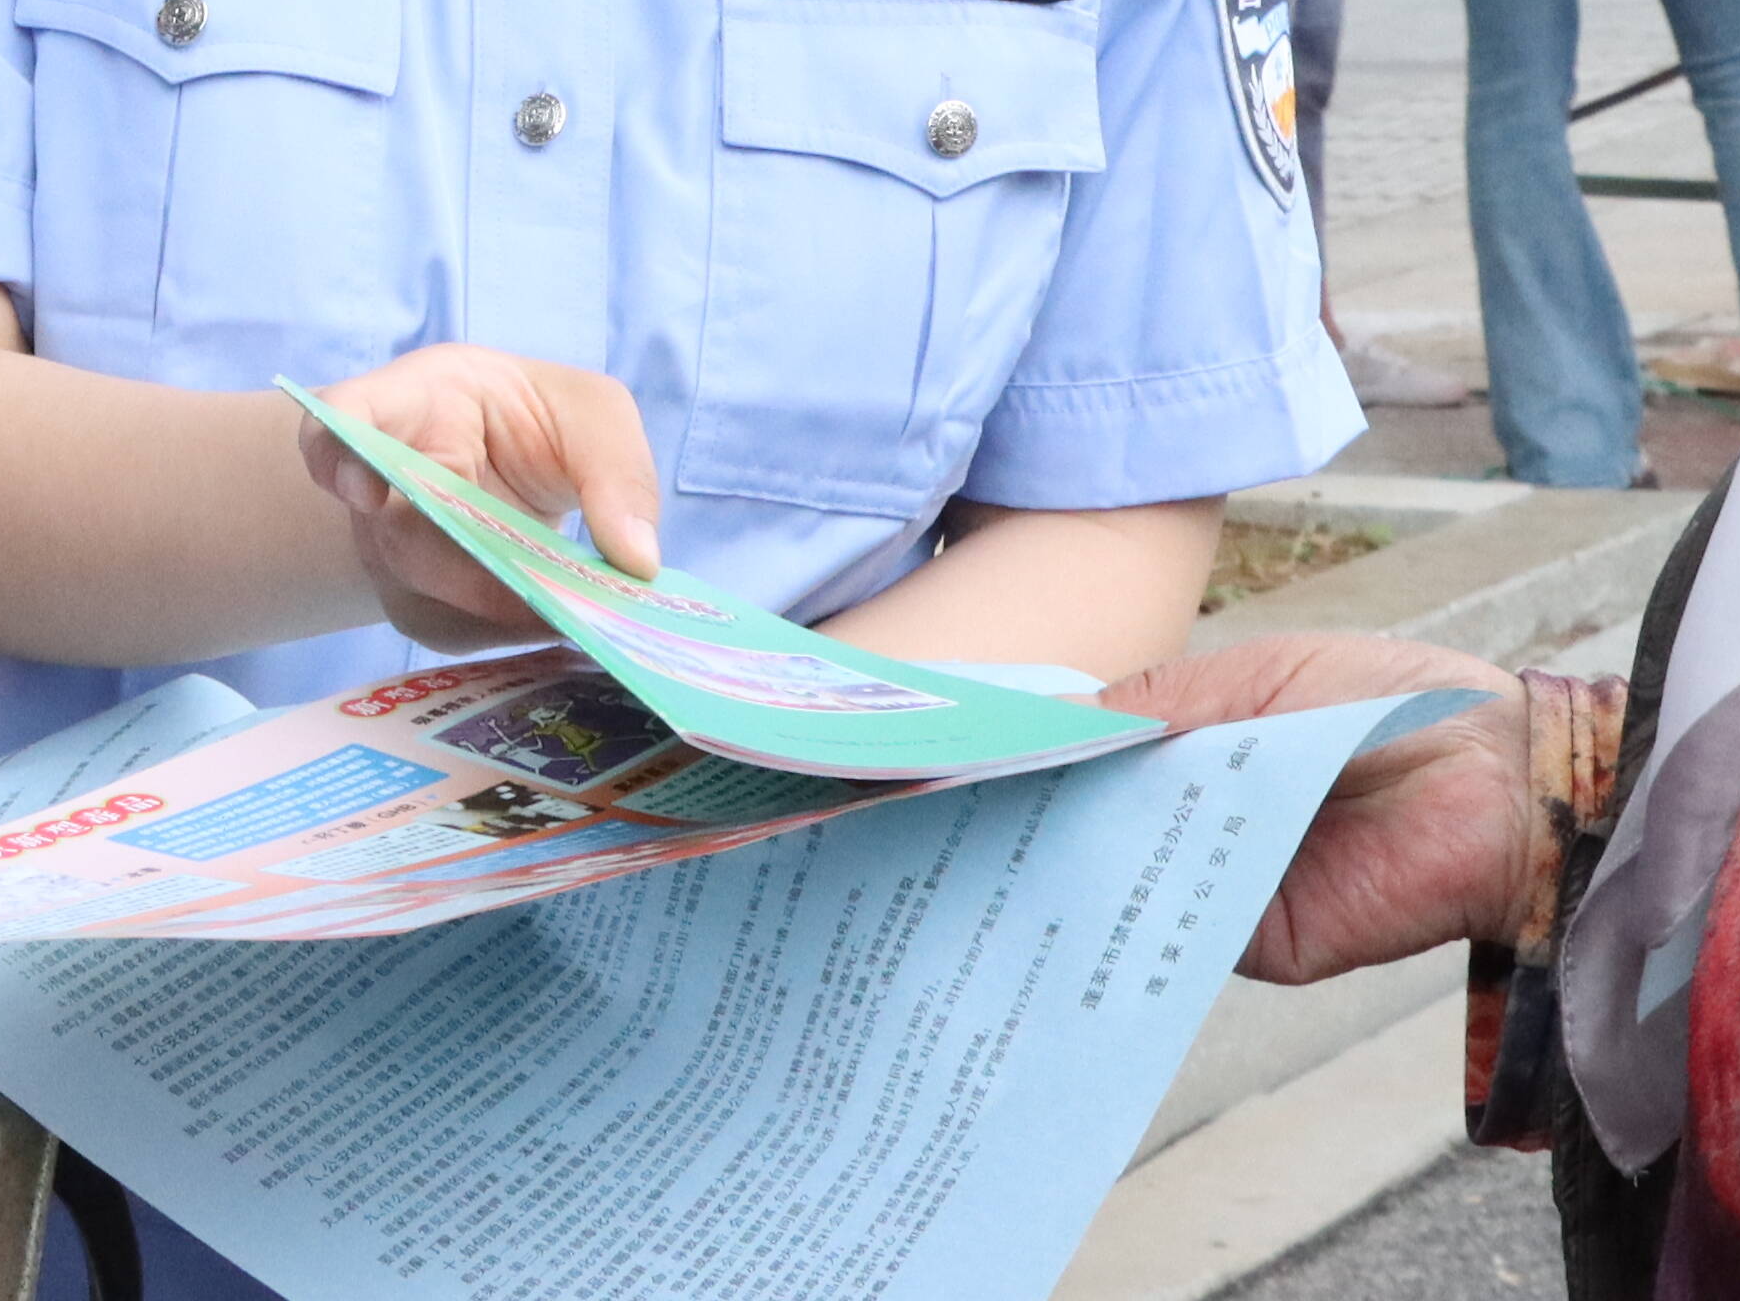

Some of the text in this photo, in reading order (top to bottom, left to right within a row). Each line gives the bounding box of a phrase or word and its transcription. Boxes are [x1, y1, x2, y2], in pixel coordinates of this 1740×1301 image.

[1080, 781, 1206, 1012] 蓬莱市禁毒委员会办公室
